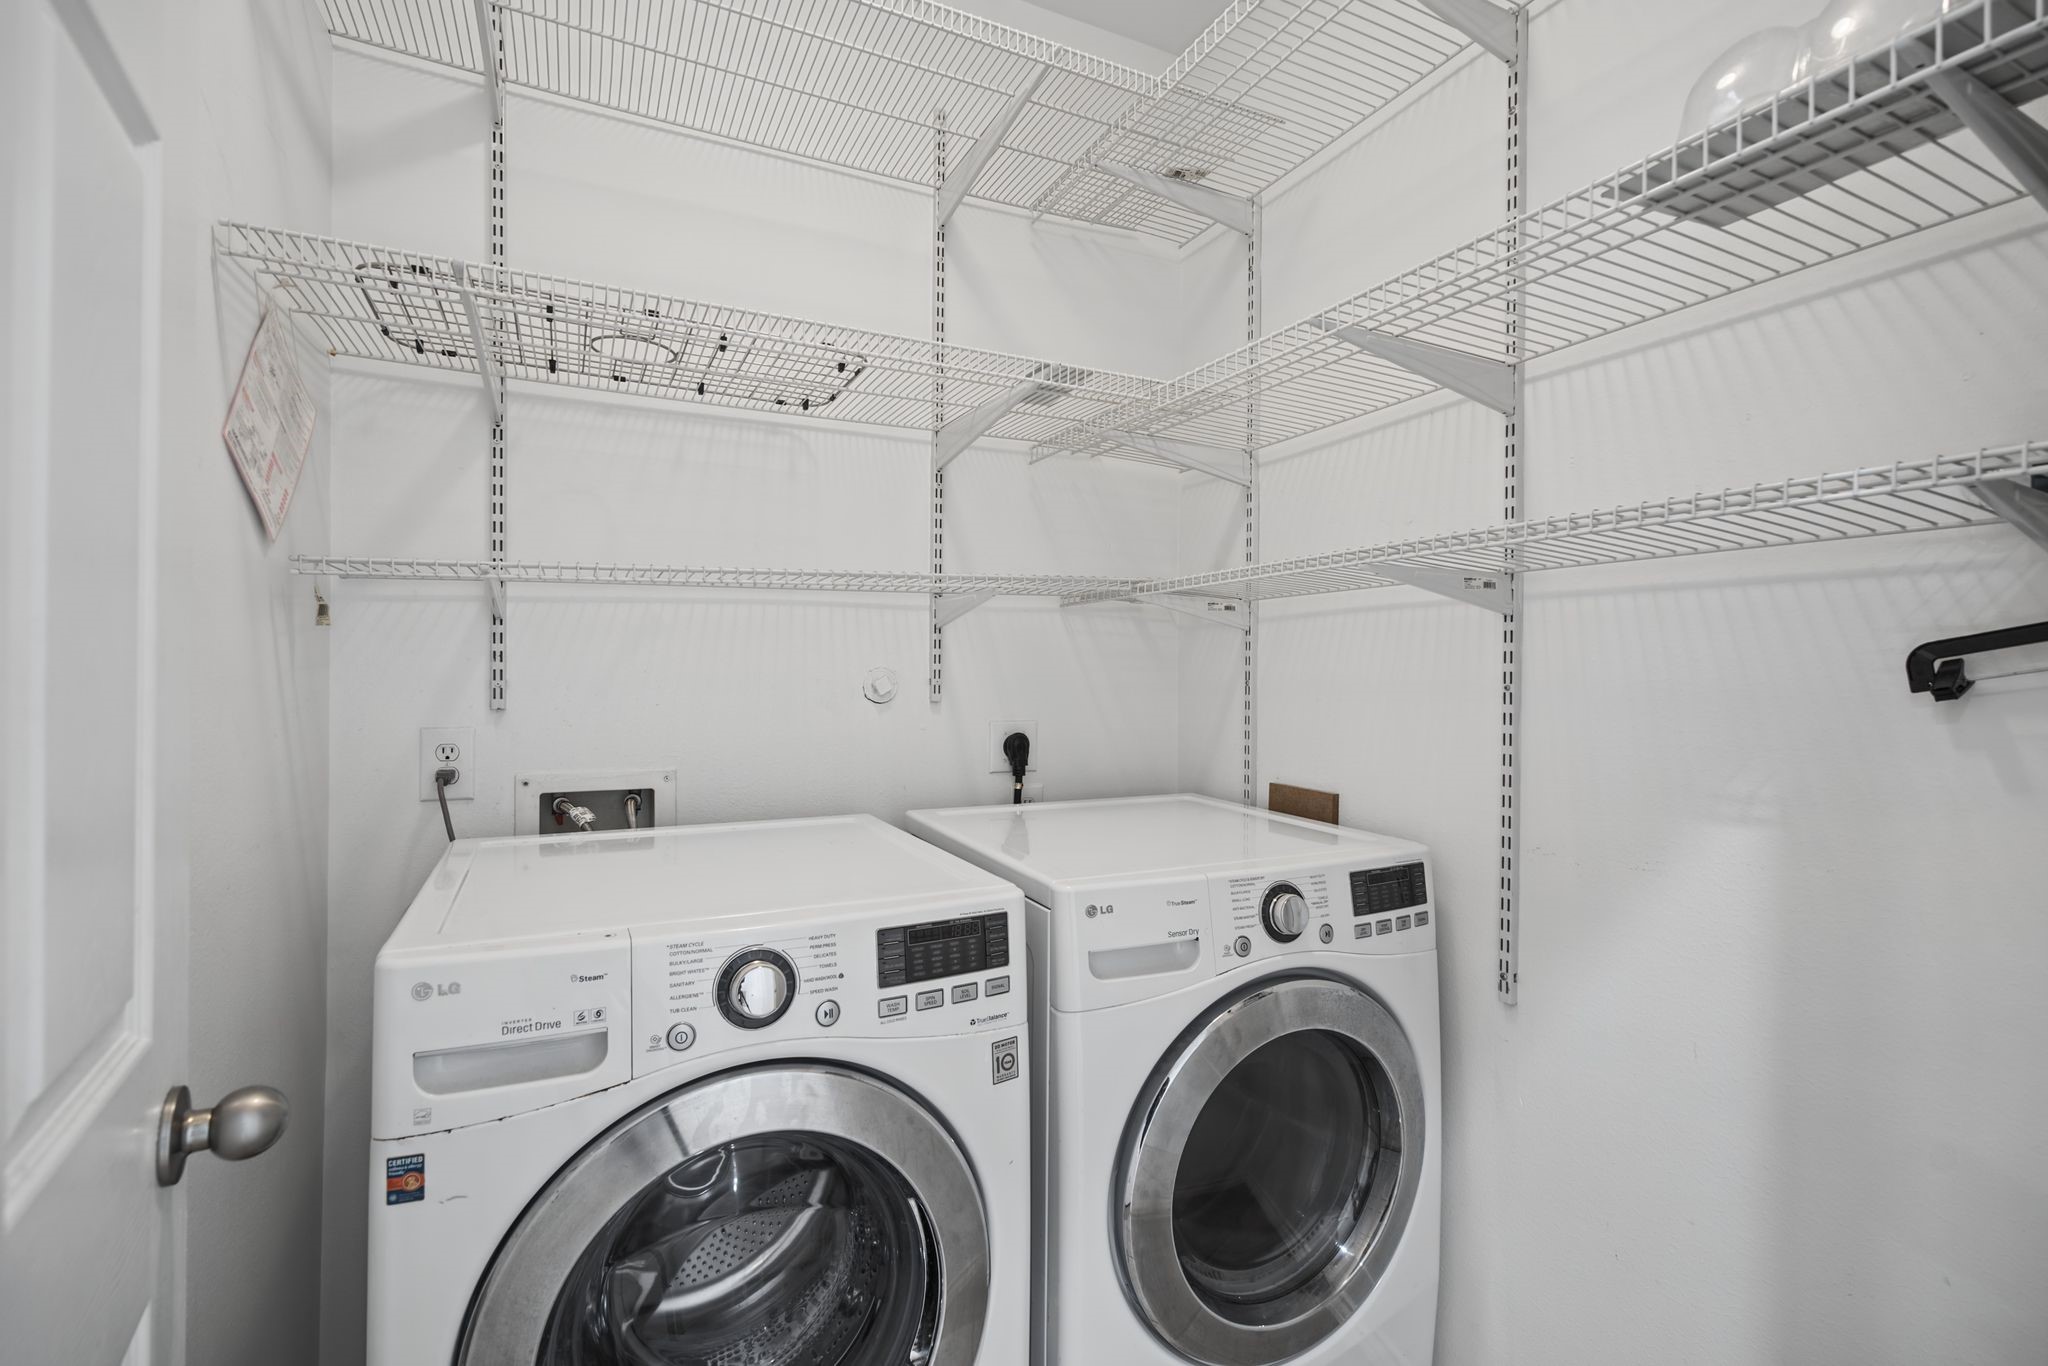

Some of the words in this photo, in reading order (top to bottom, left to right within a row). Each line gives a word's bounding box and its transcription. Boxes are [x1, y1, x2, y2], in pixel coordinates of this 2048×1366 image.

[1100, 905, 1114, 914] LG
[1167, 929, 1188, 938] Sensor
[1188, 928, 1200, 937] Dry
[669, 947, 713, 957] COTTON/NORMAL
[813, 951, 837, 959] DELICATES
[669, 969, 686, 977] BRIGHT
[437, 982, 461, 996] LG
[669, 980, 695, 988] SANITARY
[501, 1023, 533, 1036] Direct
[534, 1020, 562, 1032] Drive
[1001, 1040, 1015, 1048] MOTOR
[996, 1052, 1016, 1074] 10
[388, 1155, 423, 1168] CERTIFIED
